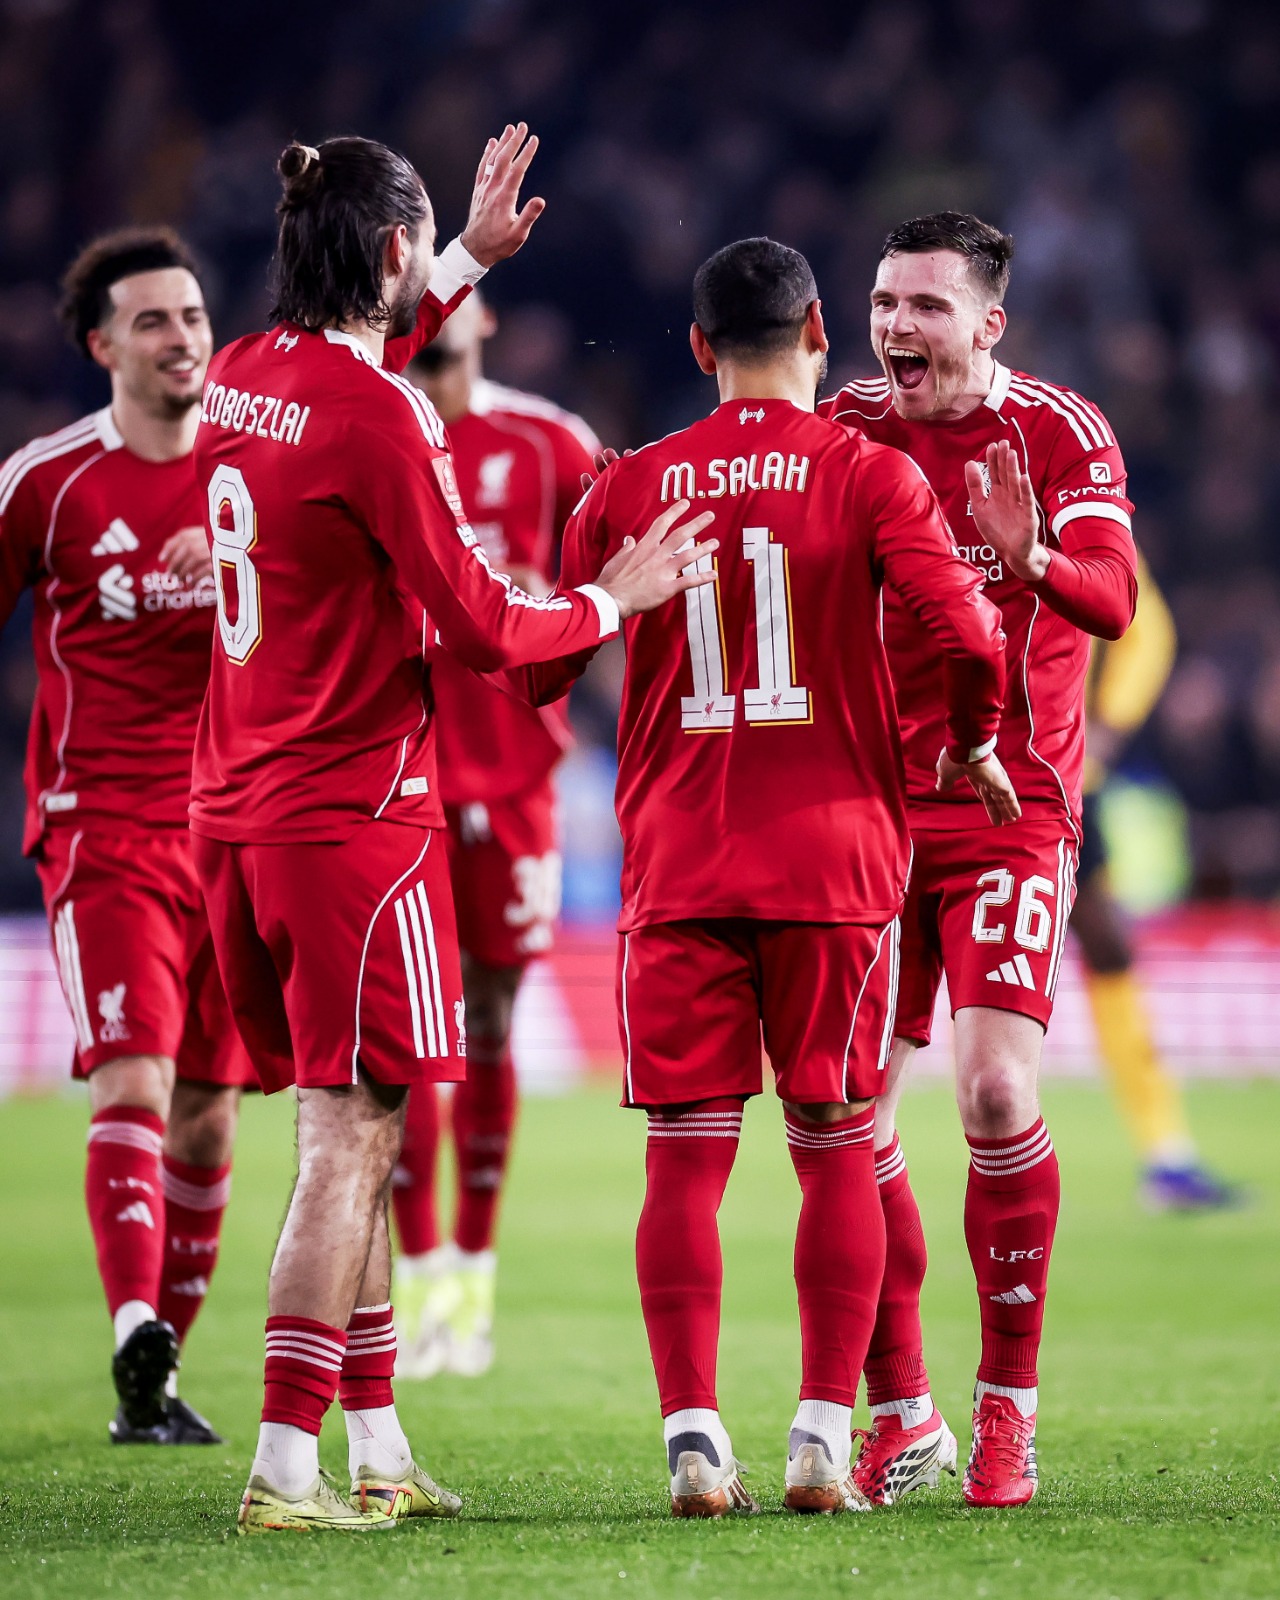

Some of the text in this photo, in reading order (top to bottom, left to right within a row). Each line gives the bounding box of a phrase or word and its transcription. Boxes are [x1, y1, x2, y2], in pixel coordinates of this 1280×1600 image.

[660, 451, 810, 502] M.SALAH
[207, 463, 262, 666] 8
[673, 526, 814, 734] 11
[972, 867, 1053, 954] 26
[989, 1246, 1044, 1264] LFC
